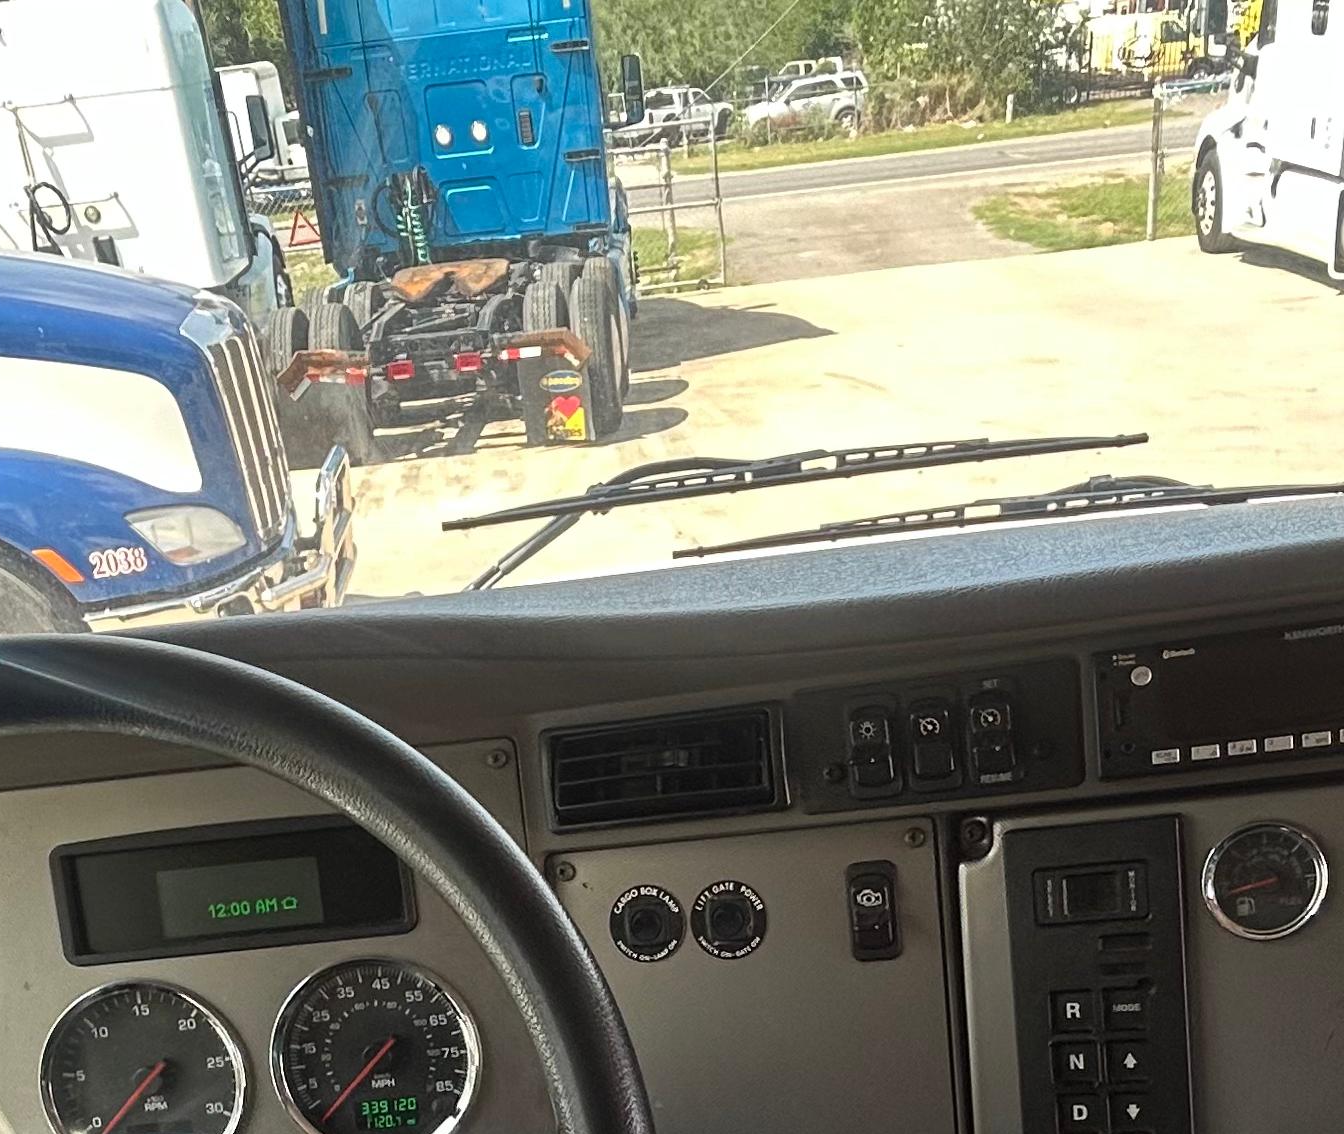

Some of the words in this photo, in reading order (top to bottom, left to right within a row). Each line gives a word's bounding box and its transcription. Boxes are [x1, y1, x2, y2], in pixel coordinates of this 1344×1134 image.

[89, 547, 147, 579] 2038
[614, 889, 638, 914] CARGO
[640, 887, 658, 897] BOX
[659, 891, 679, 912] LAMP
[695, 891, 712, 911] LIFT
[712, 882, 735, 894] GATE
[740, 885, 764, 911] POWER
[208, 901, 251, 918] 12:00
[256, 898, 278, 913] AM
[371, 978, 390, 990] 45
[336, 987, 355, 999] 35
[405, 991, 424, 1003] 55
[132, 1004, 150, 1016] 15
[1066, 1002, 1081, 1019] R
[1112, 1003, 1141, 1012] MODE
[312, 1011, 331, 1023] 25
[429, 1014, 448, 1026] 65
[178, 1018, 197, 1031] 20
[92, 1026, 109, 1039] 10
[442, 1046, 460, 1058] 75
[206, 1057, 225, 1069] 25
[1069, 1053, 1085, 1070] N
[76, 1070, 86, 1082] 5
[309, 1078, 318, 1089] 5
[371, 1078, 396, 1089] MPH
[435, 1080, 454, 1093] 85
[144, 1100, 168, 1112] RPM
[205, 1102, 224, 1114] 30
[1072, 1104, 1088, 1121] D
[92, 1116, 102, 1128] 0
